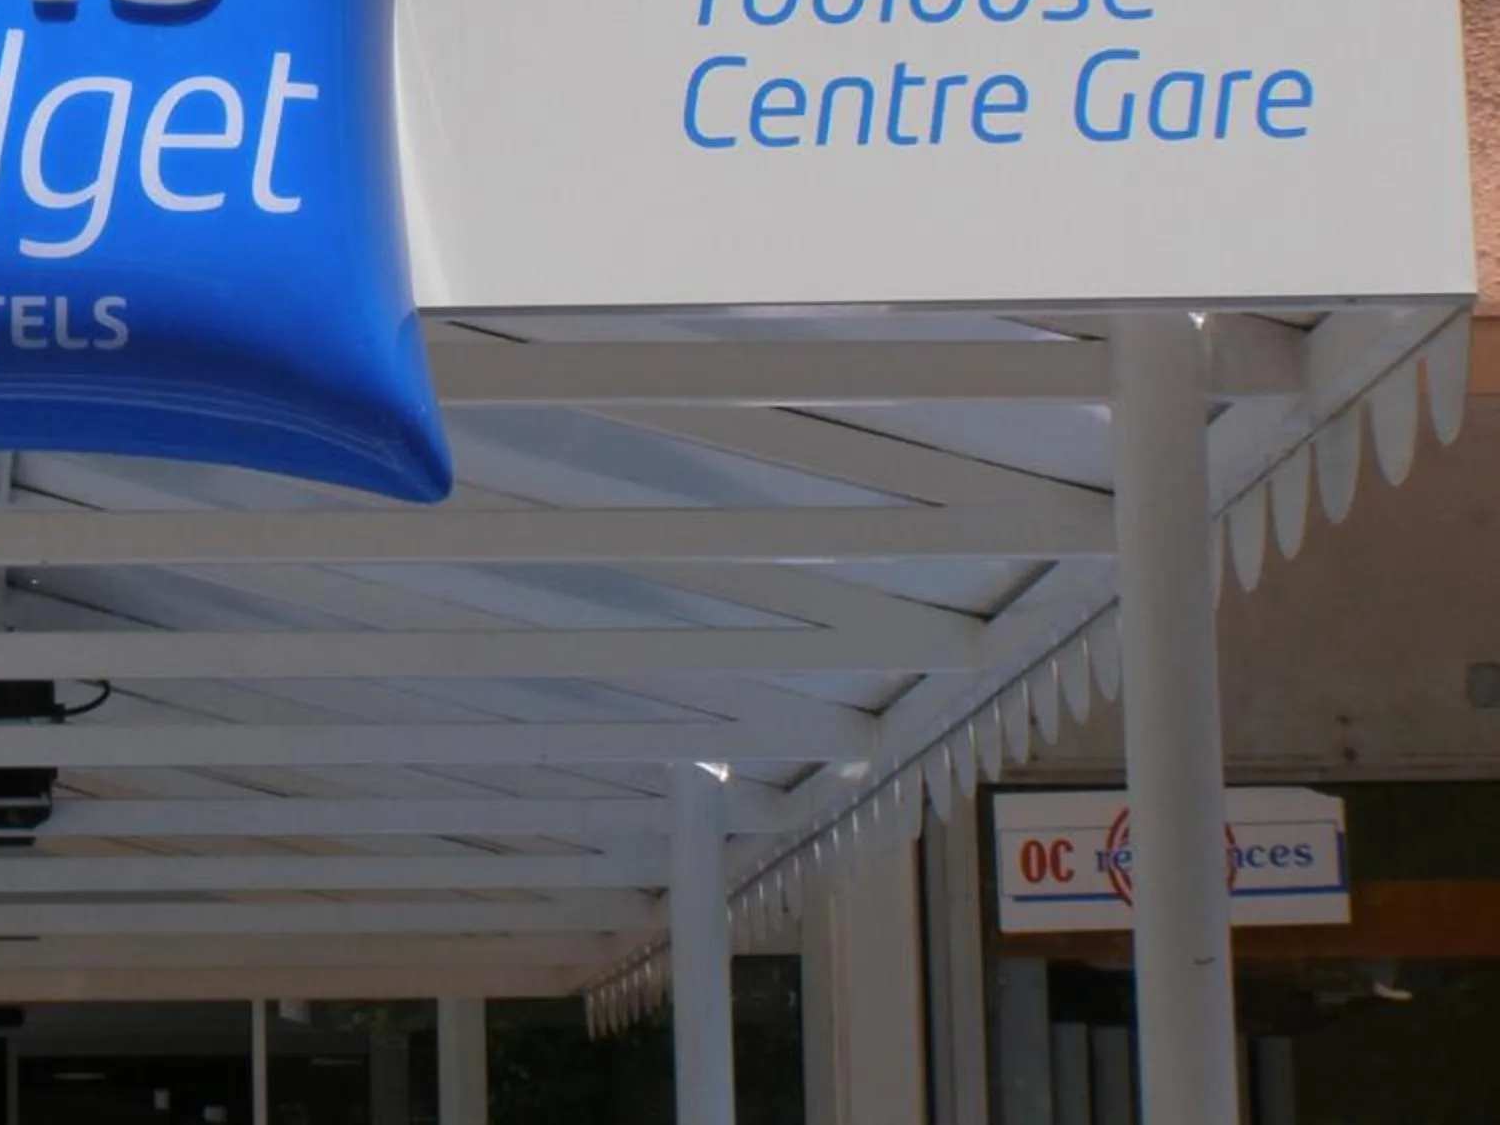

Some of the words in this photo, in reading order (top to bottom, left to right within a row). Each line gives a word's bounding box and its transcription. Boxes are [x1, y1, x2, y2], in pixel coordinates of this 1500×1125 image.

[683, 55, 1030, 148] Centre
[1073, 48, 1314, 143] Gare
[1020, 838, 1076, 883] OC
